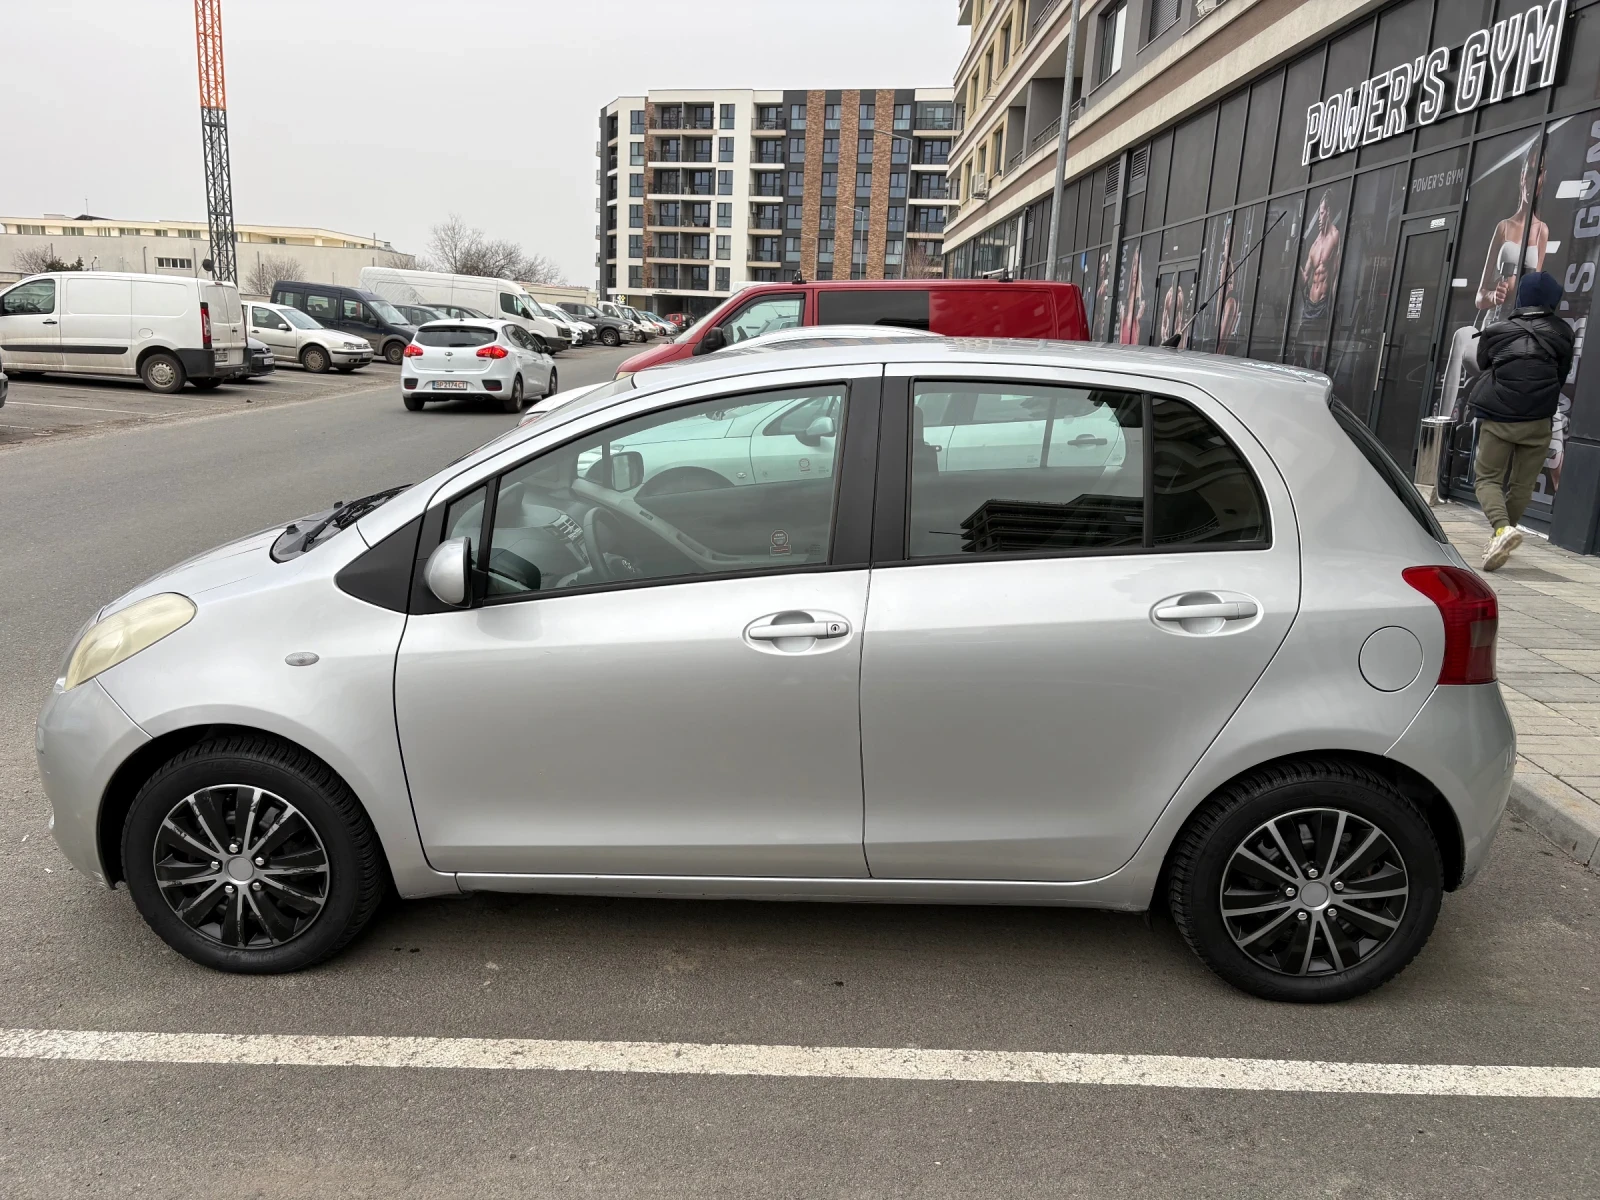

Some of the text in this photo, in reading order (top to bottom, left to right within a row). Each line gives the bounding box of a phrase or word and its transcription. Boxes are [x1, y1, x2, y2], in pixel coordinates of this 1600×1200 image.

[1302, 0, 1566, 166] POWER'S GYM
[1411, 168, 1464, 194] POWER'S GYM
